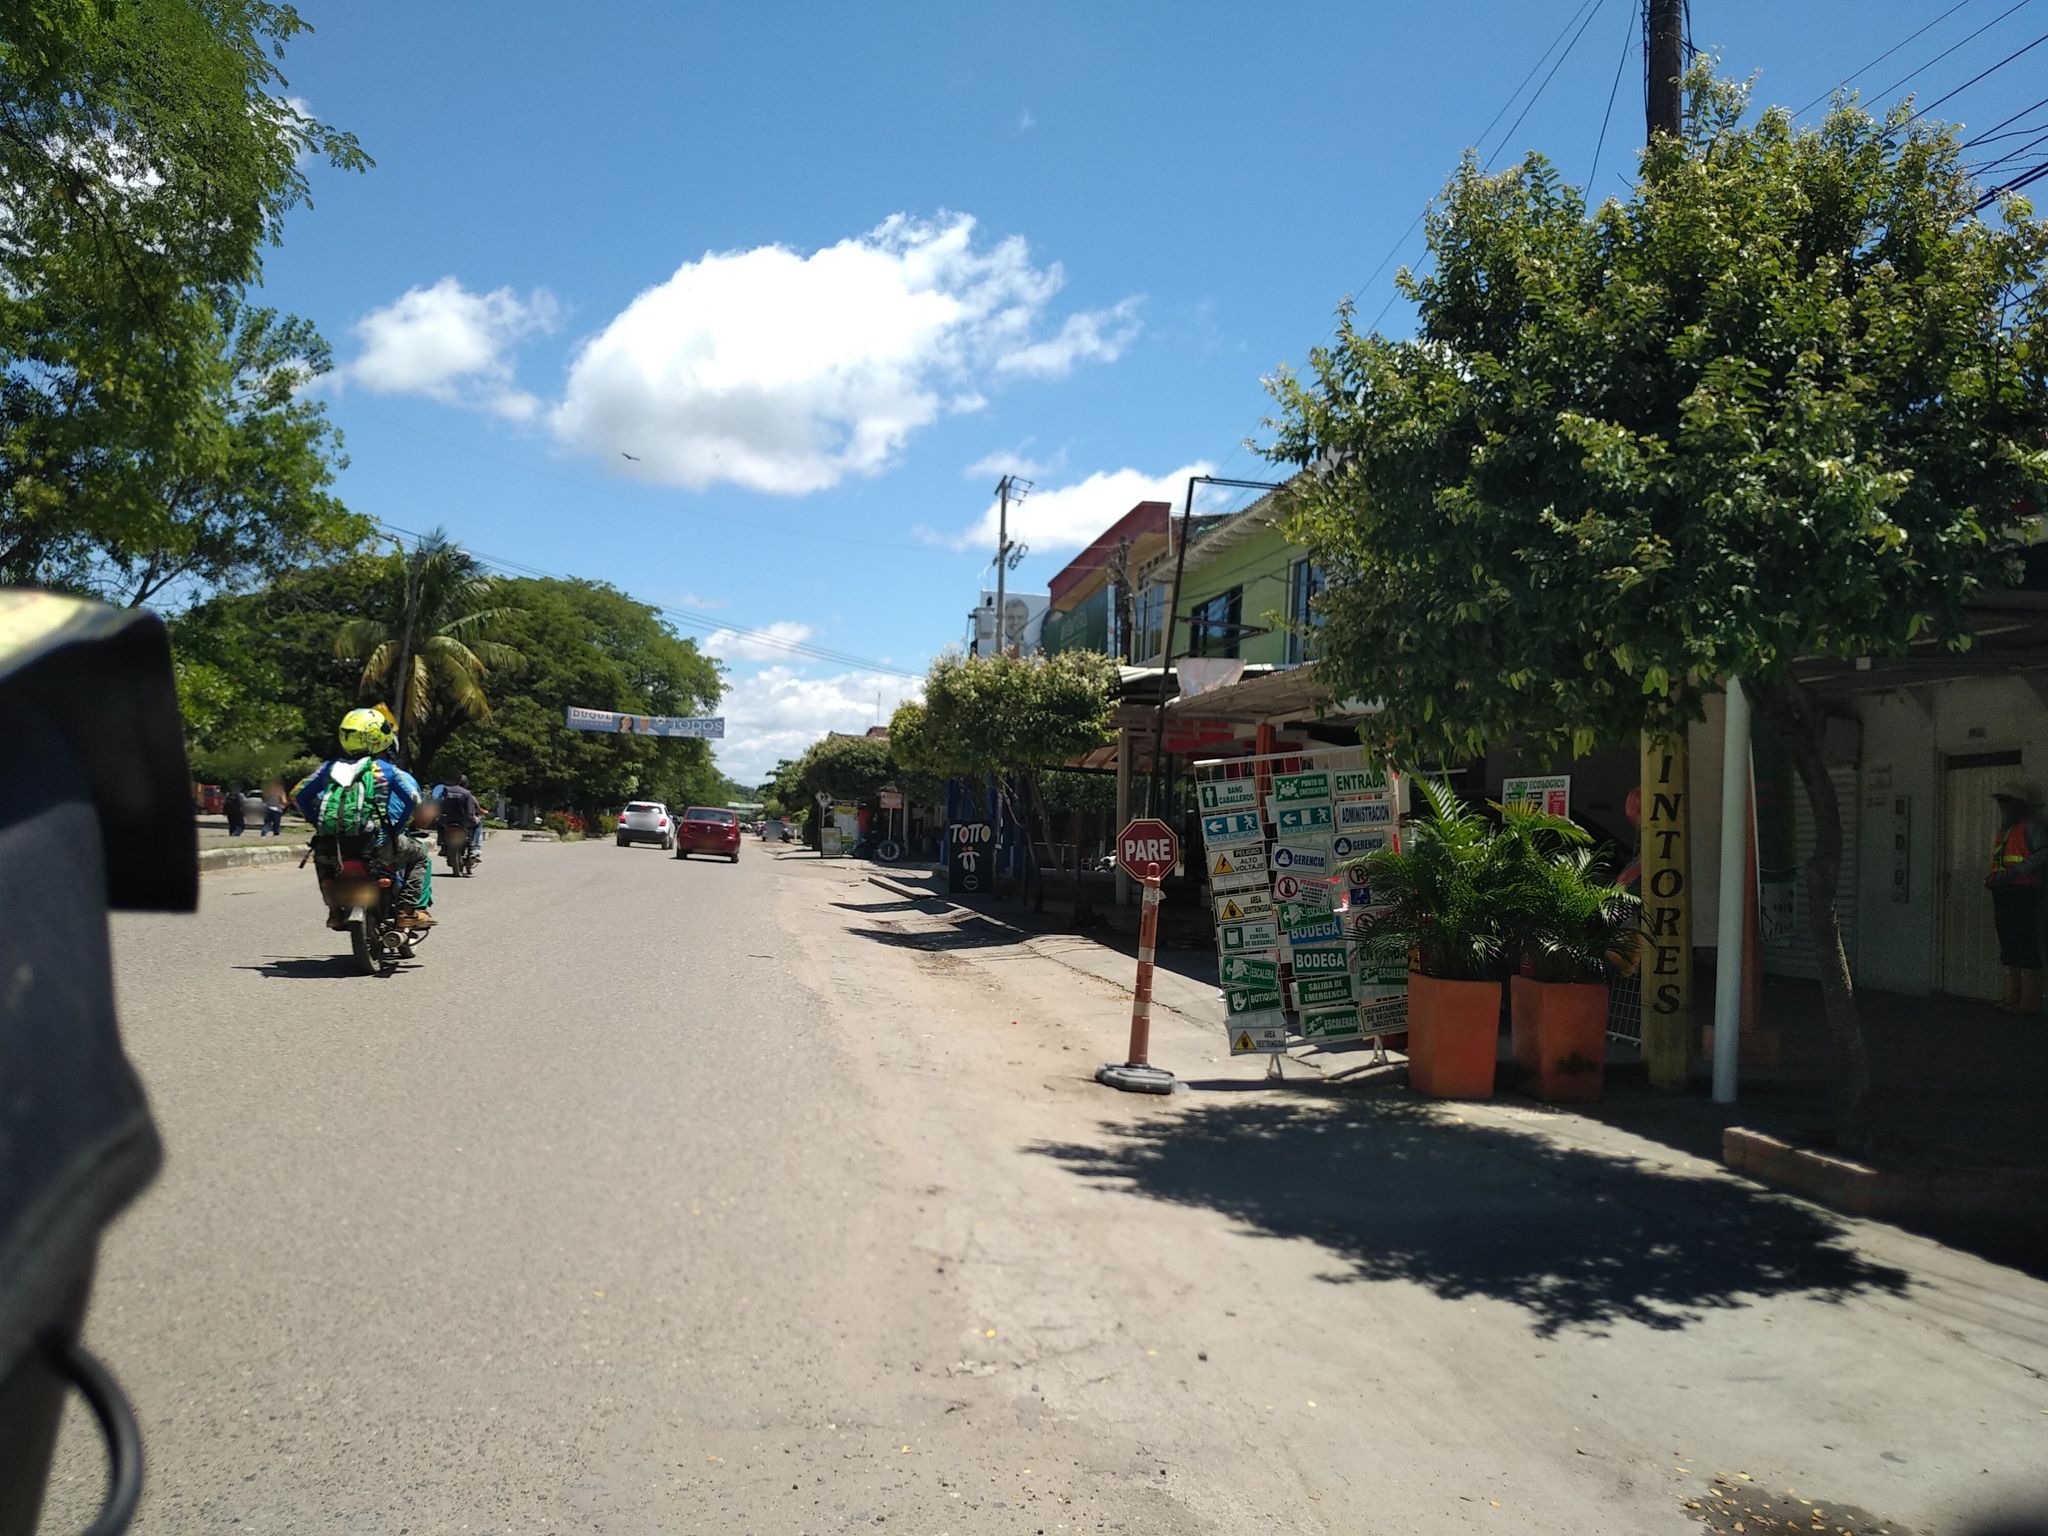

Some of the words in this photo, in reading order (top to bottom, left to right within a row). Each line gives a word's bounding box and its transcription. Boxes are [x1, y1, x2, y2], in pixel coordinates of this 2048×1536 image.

[672, 719, 723, 731] TODOS
[1336, 773, 1387, 791] ENTRADA
[1507, 781, 1528, 790] PUNTO
[1218, 793, 1254, 804] CABALLEROS
[950, 823, 991, 843] TOTTO
[1124, 838, 1171, 862] PARE
[1234, 848, 1260, 856] PELIGRO
[1293, 854, 1325, 867] GERENCIA
[1234, 863, 1264, 871] VOLTAJE
[1647, 753, 1683, 1014] INTORES
[1292, 922, 1340, 938] BODEGA
[1296, 953, 1345, 968] BODEGA
[1251, 967, 1274, 980] ESCALERA
[1308, 981, 1332, 991] SALIDA
[1334, 979, 1343, 988] DE
[1304, 989, 1348, 1001] EMERGENCIA
[1367, 1014, 1375, 1022] DE
[1372, 1018, 1406, 1028] INDUSTRIAL
